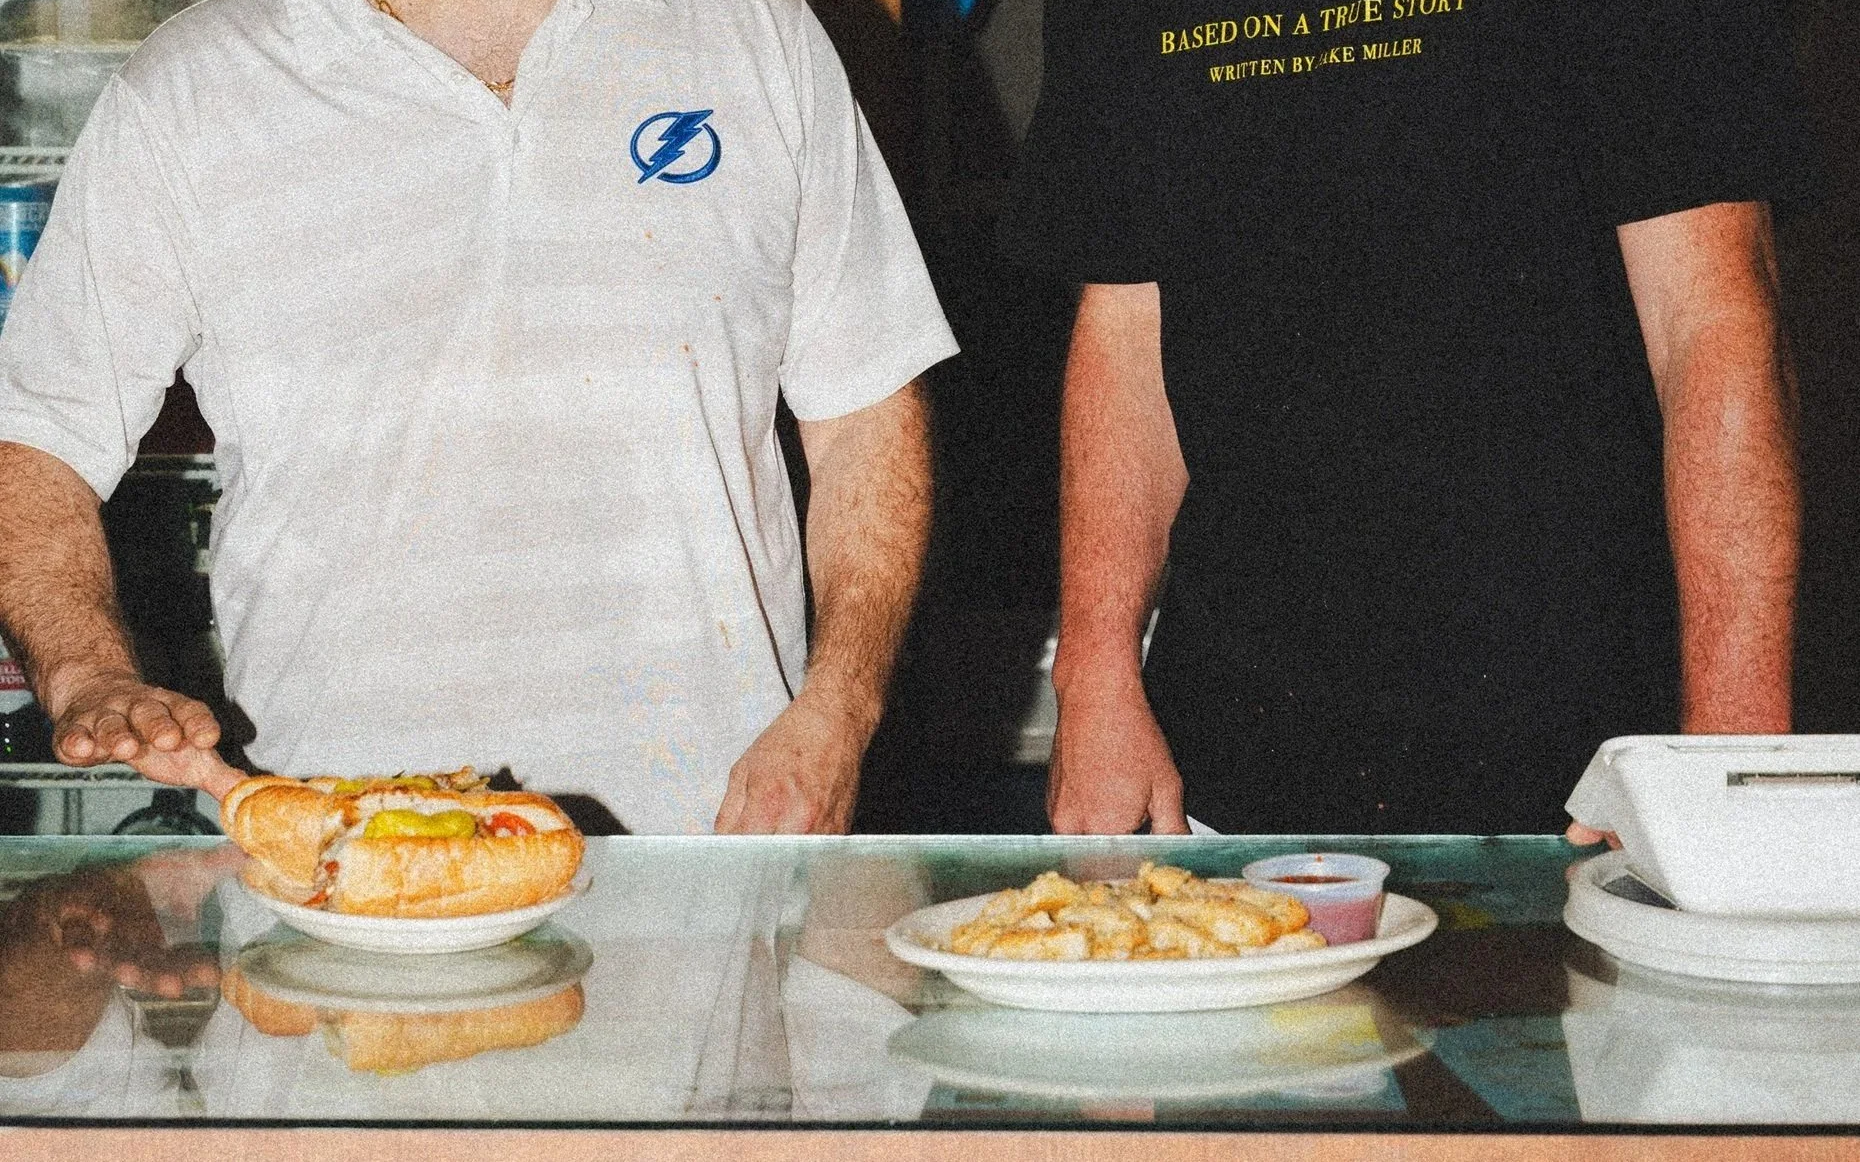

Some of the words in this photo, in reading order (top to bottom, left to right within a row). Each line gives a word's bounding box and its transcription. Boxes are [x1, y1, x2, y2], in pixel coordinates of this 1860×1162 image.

[1160, 20, 1238, 54] BASED
[1244, 14, 1283, 39] ON
[1292, 13, 1311, 35] A
[1209, 59, 1286, 83] WRITTEN
[1292, 56, 1315, 74] BY
[1361, 38, 1423, 61] MILLER
